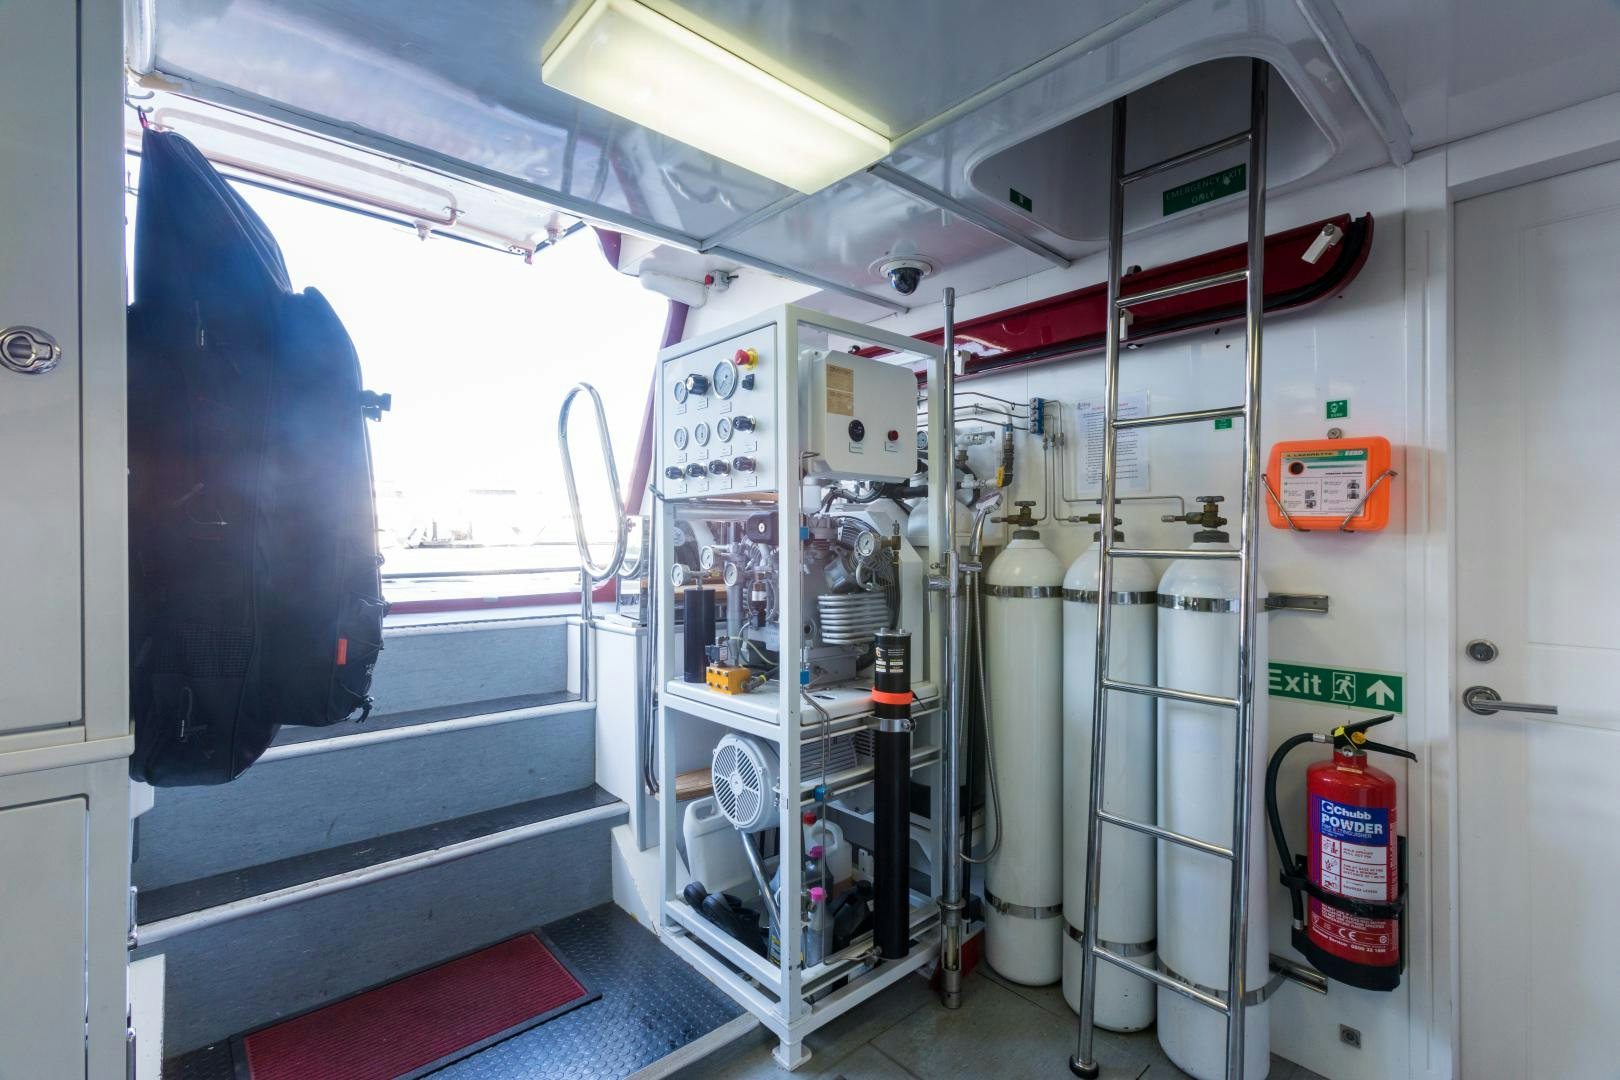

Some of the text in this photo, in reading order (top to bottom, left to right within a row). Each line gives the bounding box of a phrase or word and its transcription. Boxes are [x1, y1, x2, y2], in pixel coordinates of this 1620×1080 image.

[1166, 168, 1242, 200] EMERGENCY EXIT
[1191, 190, 1216, 204] ONLY
[1268, 669, 1322, 696] Exit
[1321, 812, 1383, 835] POWDER
[1333, 805, 1372, 820] Chubb
